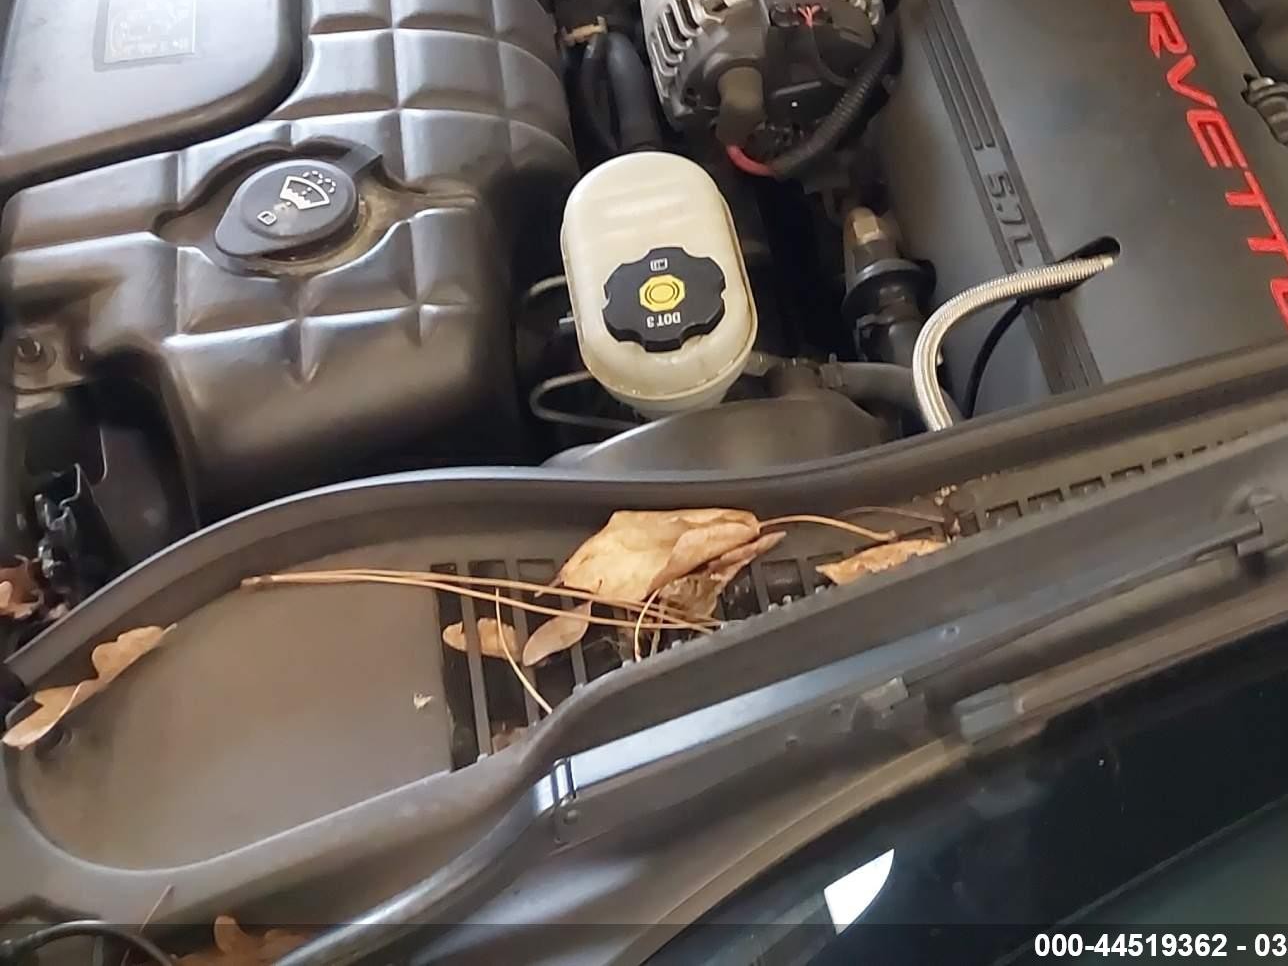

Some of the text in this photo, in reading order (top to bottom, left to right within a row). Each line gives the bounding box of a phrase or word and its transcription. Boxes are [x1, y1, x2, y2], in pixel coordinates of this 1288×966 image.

[984, 171, 1033, 267] 5.7L
[646, 311, 681, 328] DOT 3
